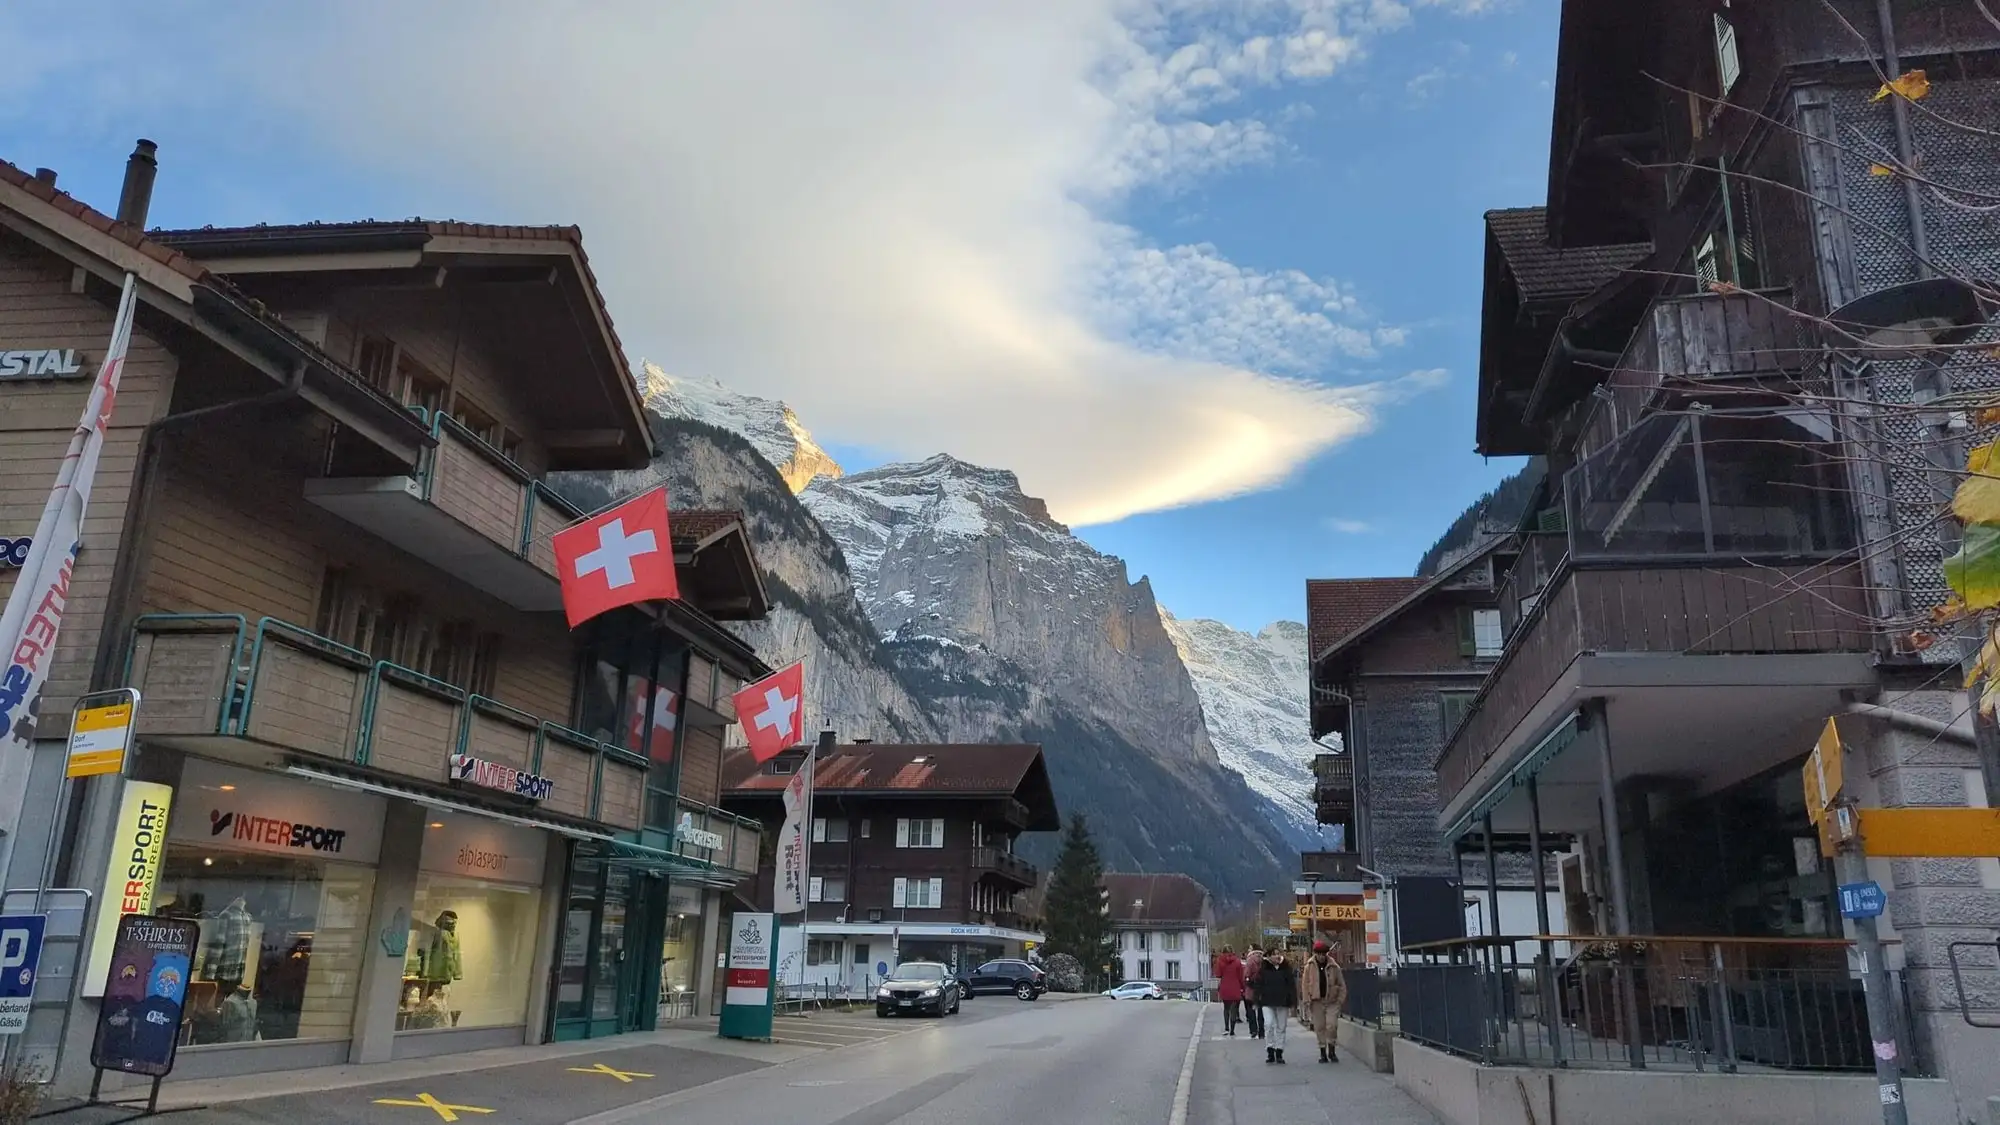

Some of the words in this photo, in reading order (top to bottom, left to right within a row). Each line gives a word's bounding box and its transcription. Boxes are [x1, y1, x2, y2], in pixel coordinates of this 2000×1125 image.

[0, 348, 80, 376] STAL
[475, 759, 553, 800] INTERSPORT
[232, 813, 346, 853] INTERSPORT
[693, 828, 723, 850] CRYSTAL
[121, 800, 158, 914] ERSPORT
[140, 869, 155, 914] FRAU
[150, 807, 167, 865] REGION
[784, 845, 794, 892] Rent
[1336, 907, 1361, 918] BAR
[0, 928, 30, 981] P
[126, 927, 185, 944] T-SHIRTS
